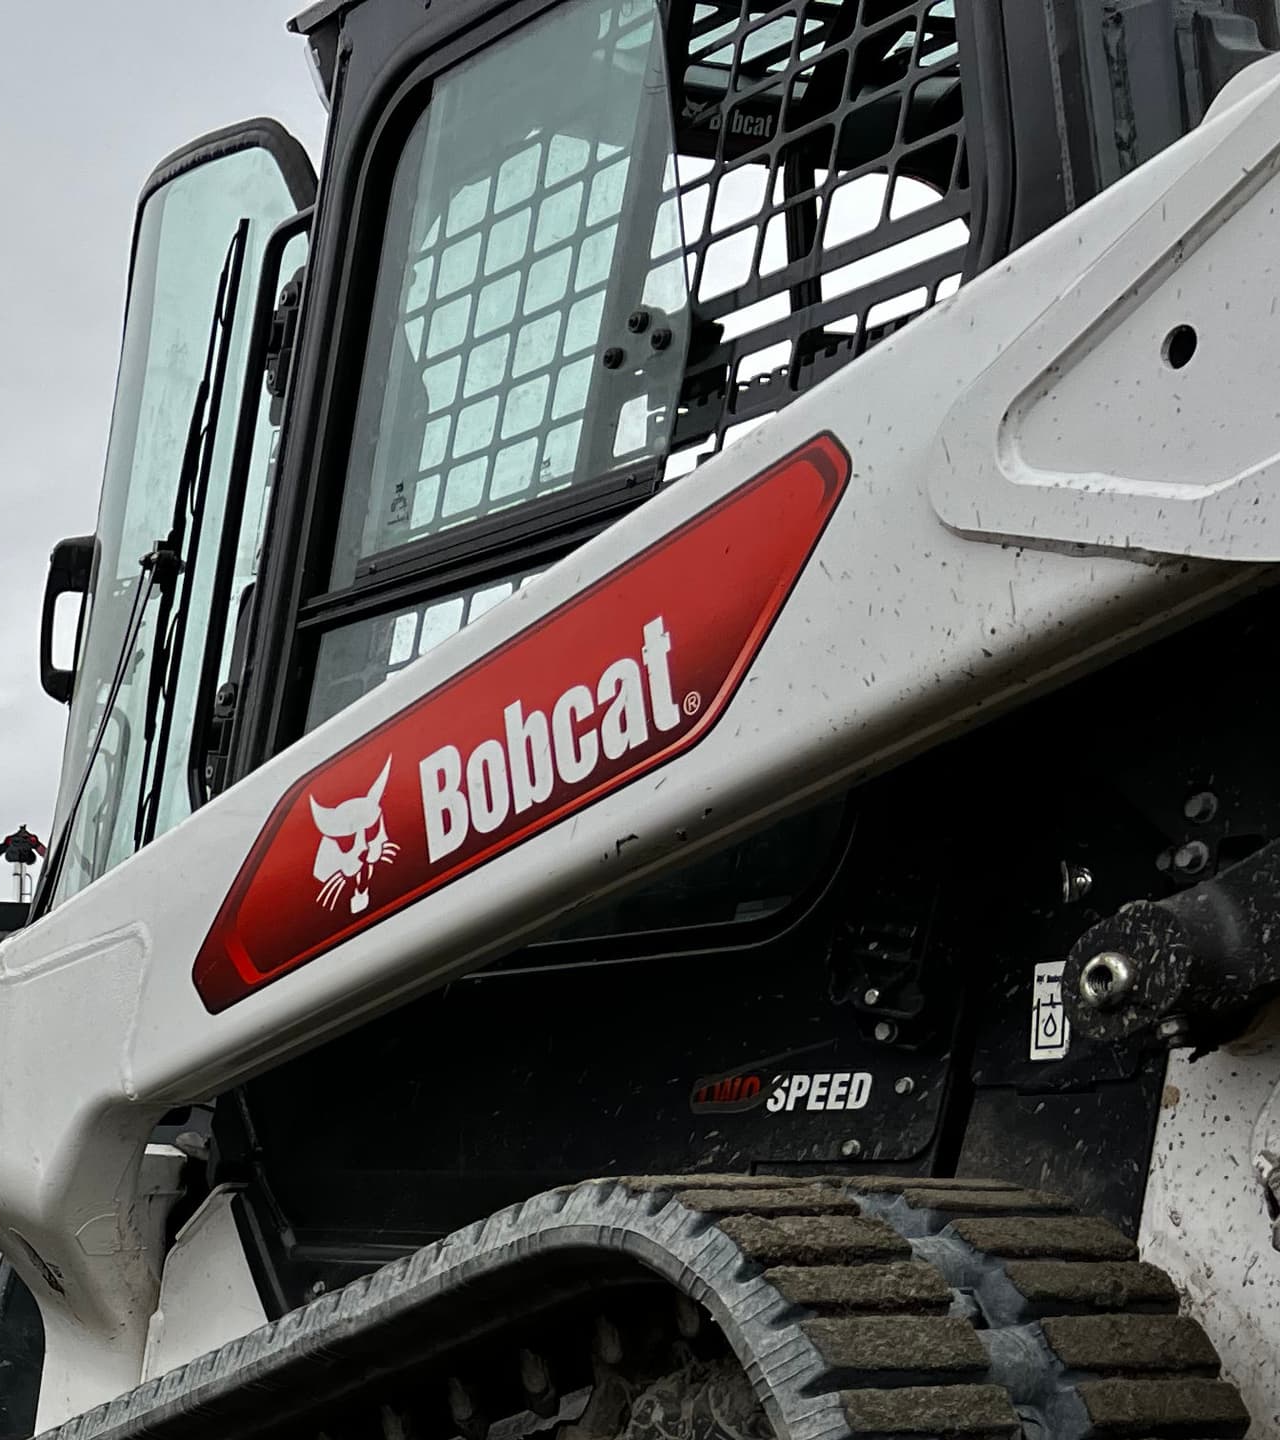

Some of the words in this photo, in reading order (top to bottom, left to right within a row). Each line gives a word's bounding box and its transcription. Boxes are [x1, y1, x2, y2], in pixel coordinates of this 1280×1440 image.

[708, 109, 773, 138] Bbcat
[419, 615, 681, 864] Bobcat
[766, 1072, 873, 1112] SPEED
